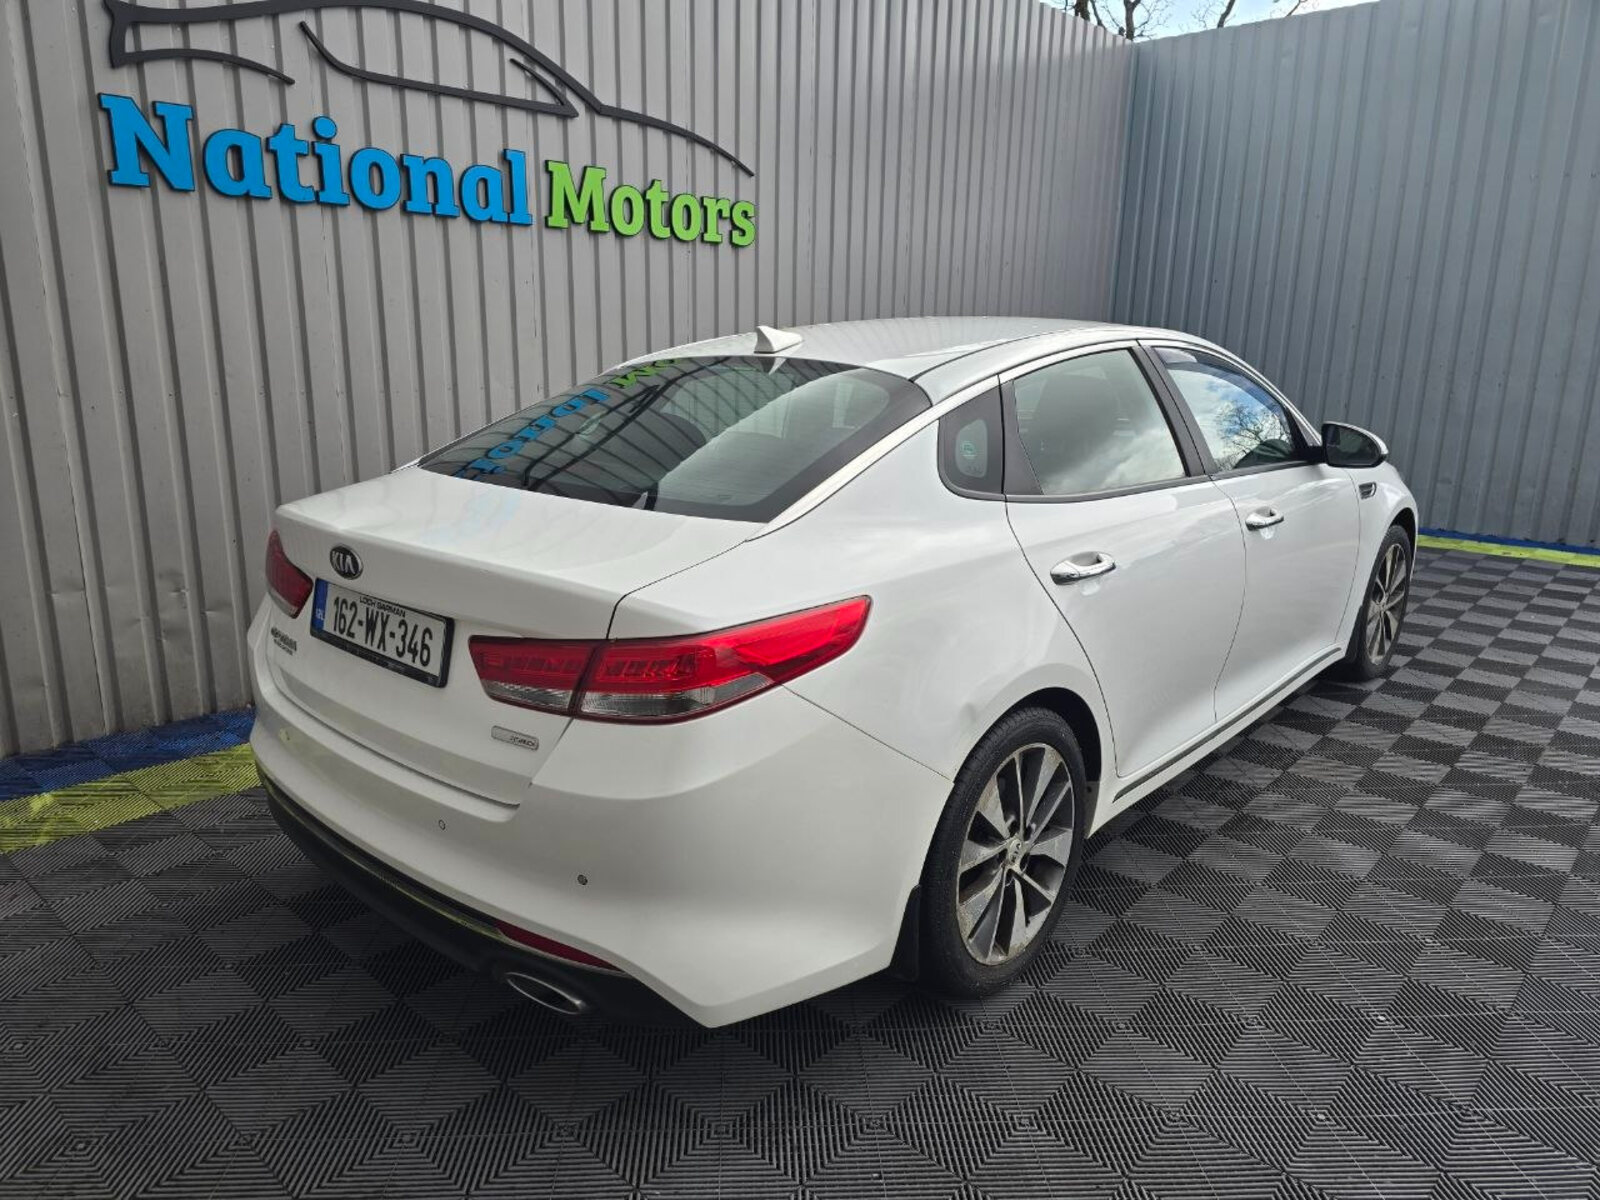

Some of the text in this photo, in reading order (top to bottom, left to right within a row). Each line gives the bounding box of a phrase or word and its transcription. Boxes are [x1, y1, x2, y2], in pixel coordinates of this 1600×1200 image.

[99, 92, 757, 247] National Motors
[331, 549, 357, 576] KIA
[359, 596, 376, 608] LOCH
[333, 596, 434, 667] 162-WX-346
